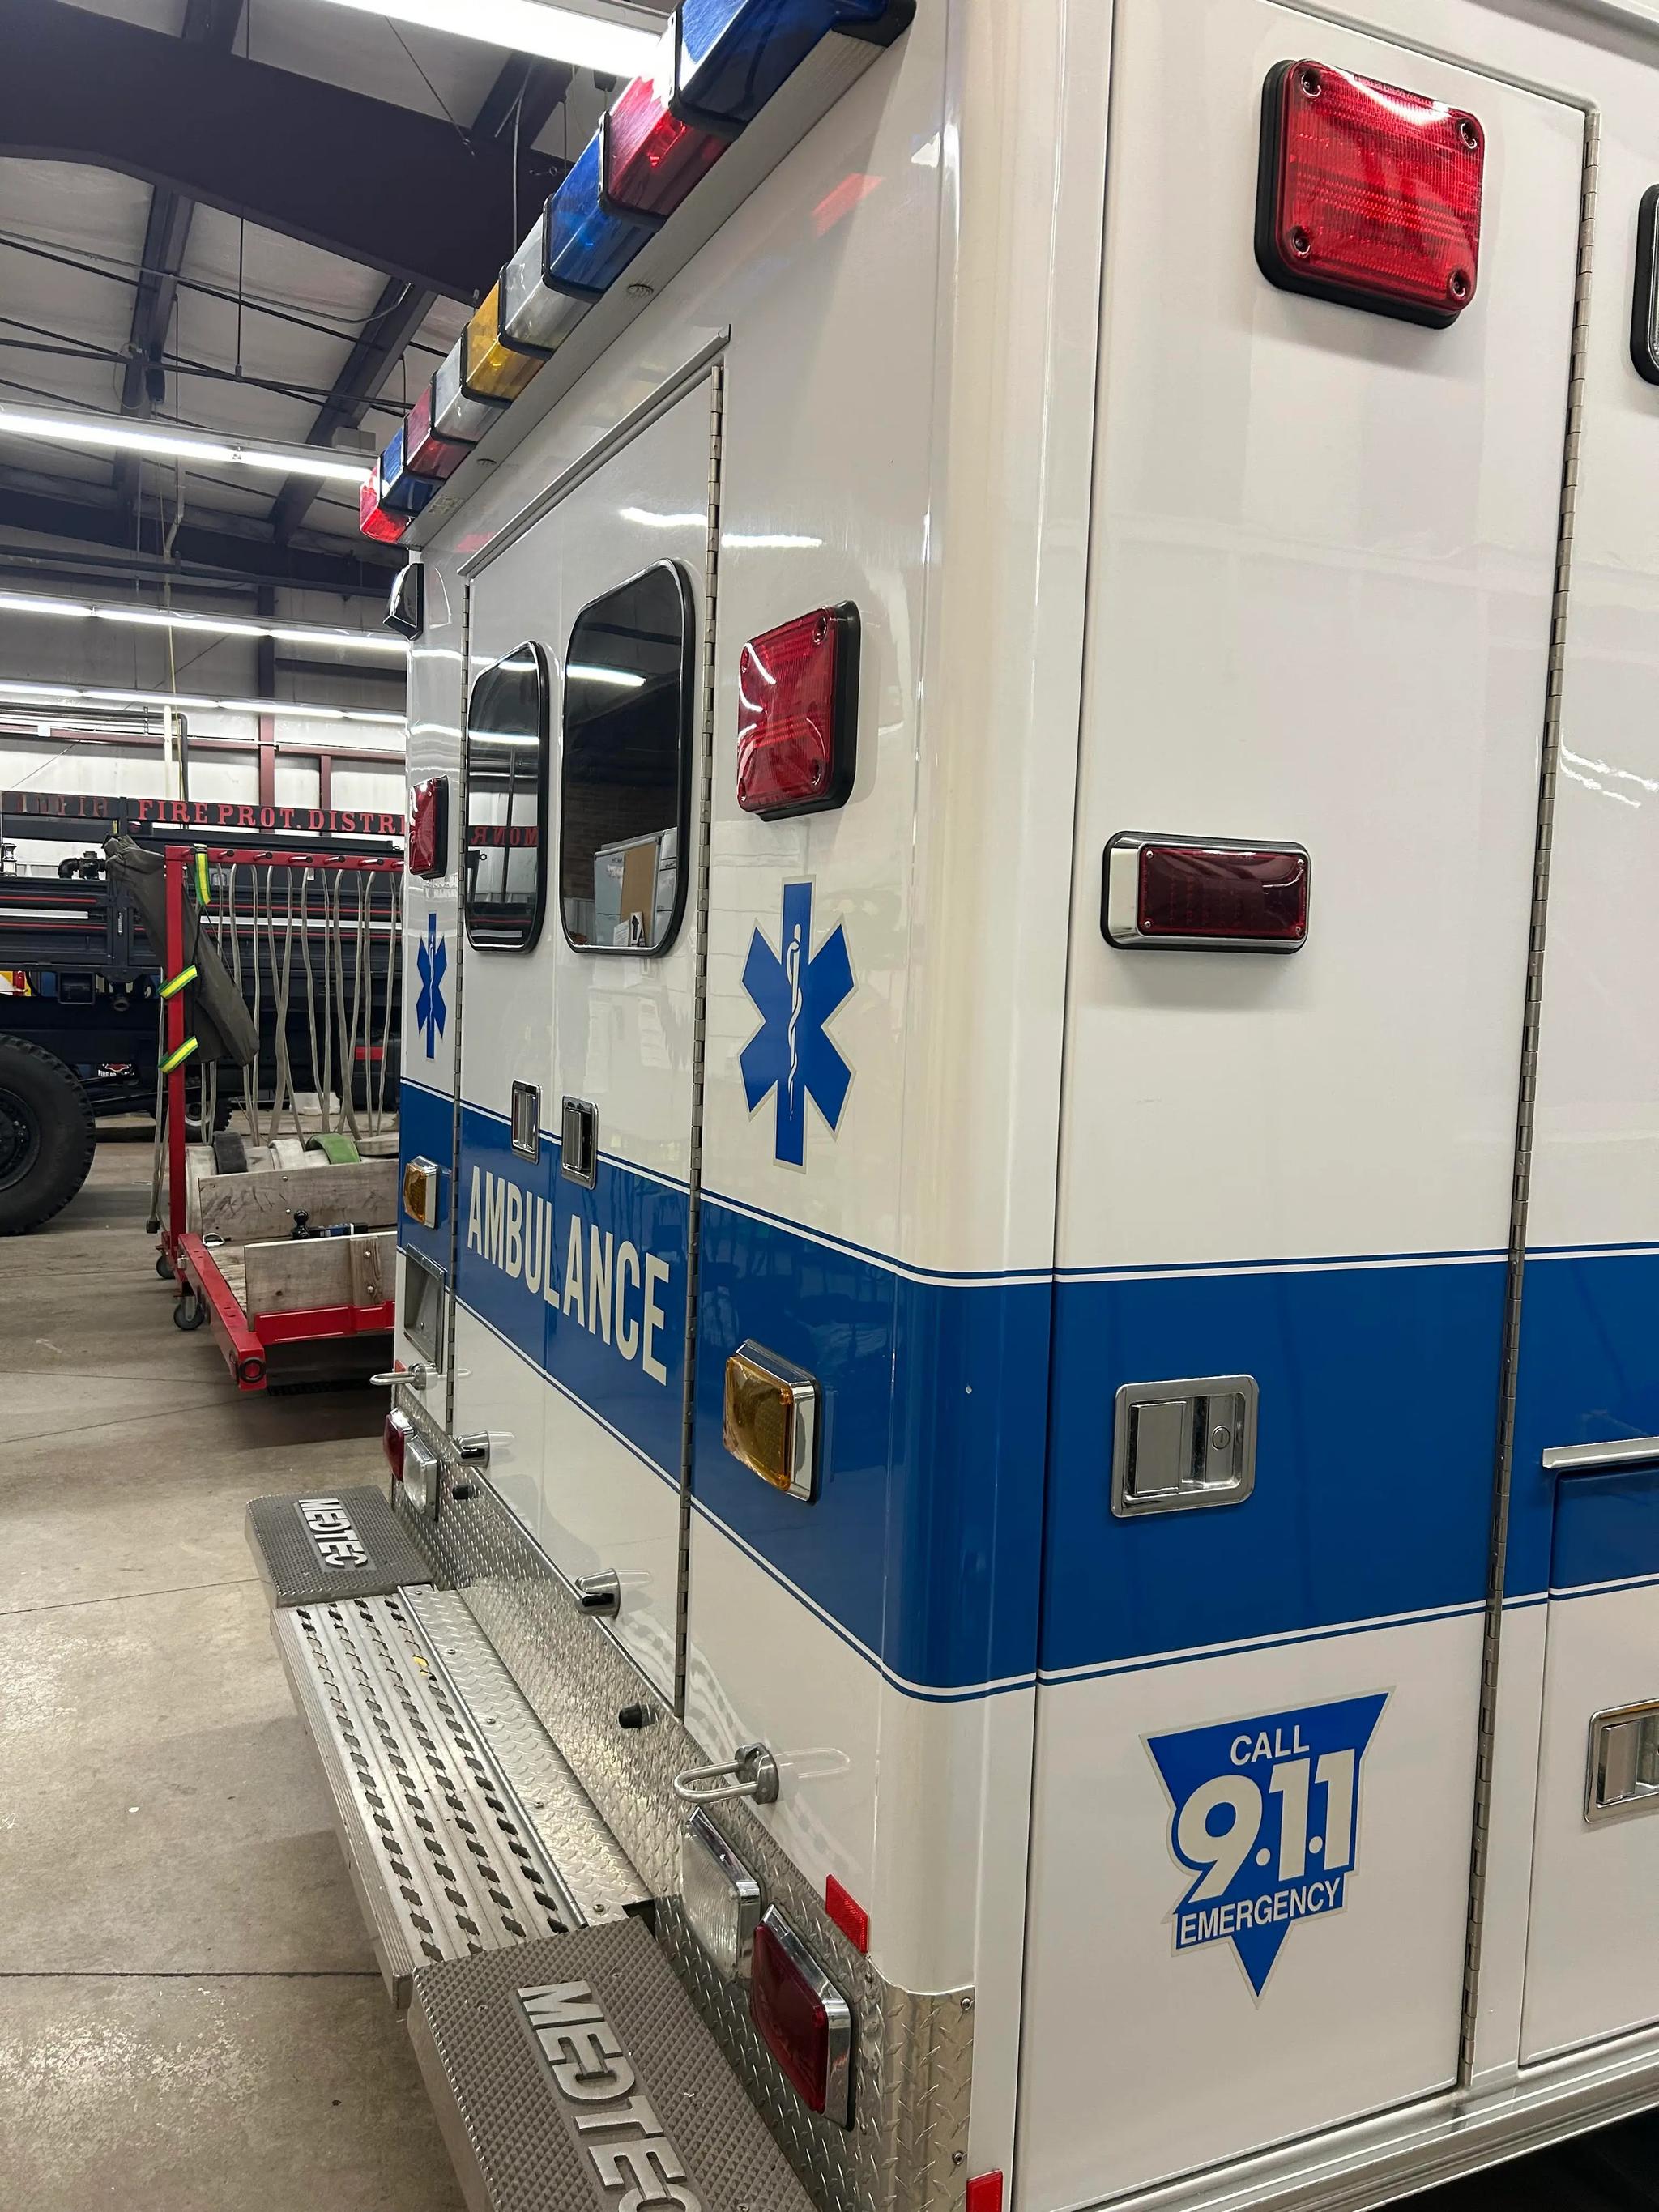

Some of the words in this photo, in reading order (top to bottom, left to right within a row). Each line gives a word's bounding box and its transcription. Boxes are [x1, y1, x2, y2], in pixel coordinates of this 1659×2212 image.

[137, 799, 207, 824] FIRE
[217, 803, 301, 829] PROT.
[467, 1165, 670, 1386] AMBULANCE
[298, 1497, 368, 1570] MEDTEC
[1230, 1724, 1310, 1766] CALL
[1180, 1877, 1341, 1946] EMERGENCY
